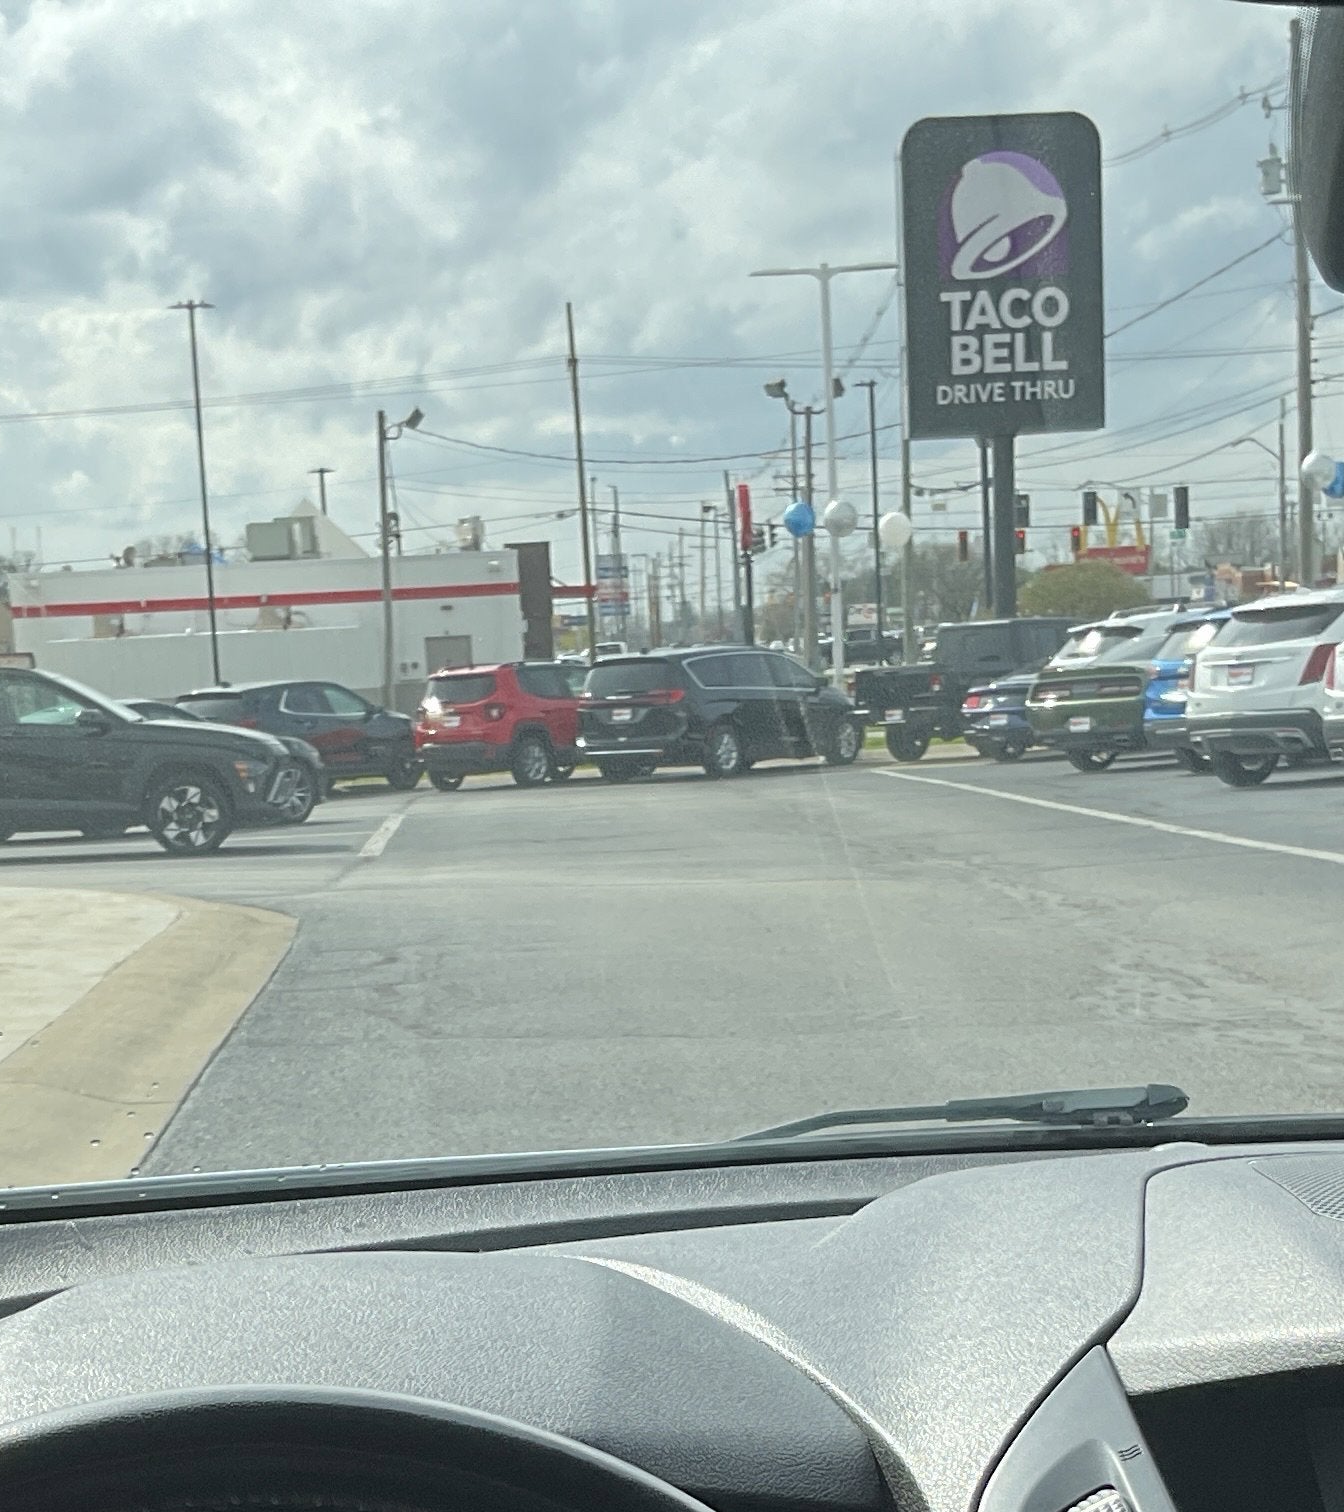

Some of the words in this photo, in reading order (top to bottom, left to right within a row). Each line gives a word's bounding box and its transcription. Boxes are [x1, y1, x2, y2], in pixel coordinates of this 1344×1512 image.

[940, 286, 1070, 332] TACO
[950, 331, 1069, 376] BELL
[936, 382, 1006, 406] DRIVE
[1010, 379, 1076, 401] THRU
